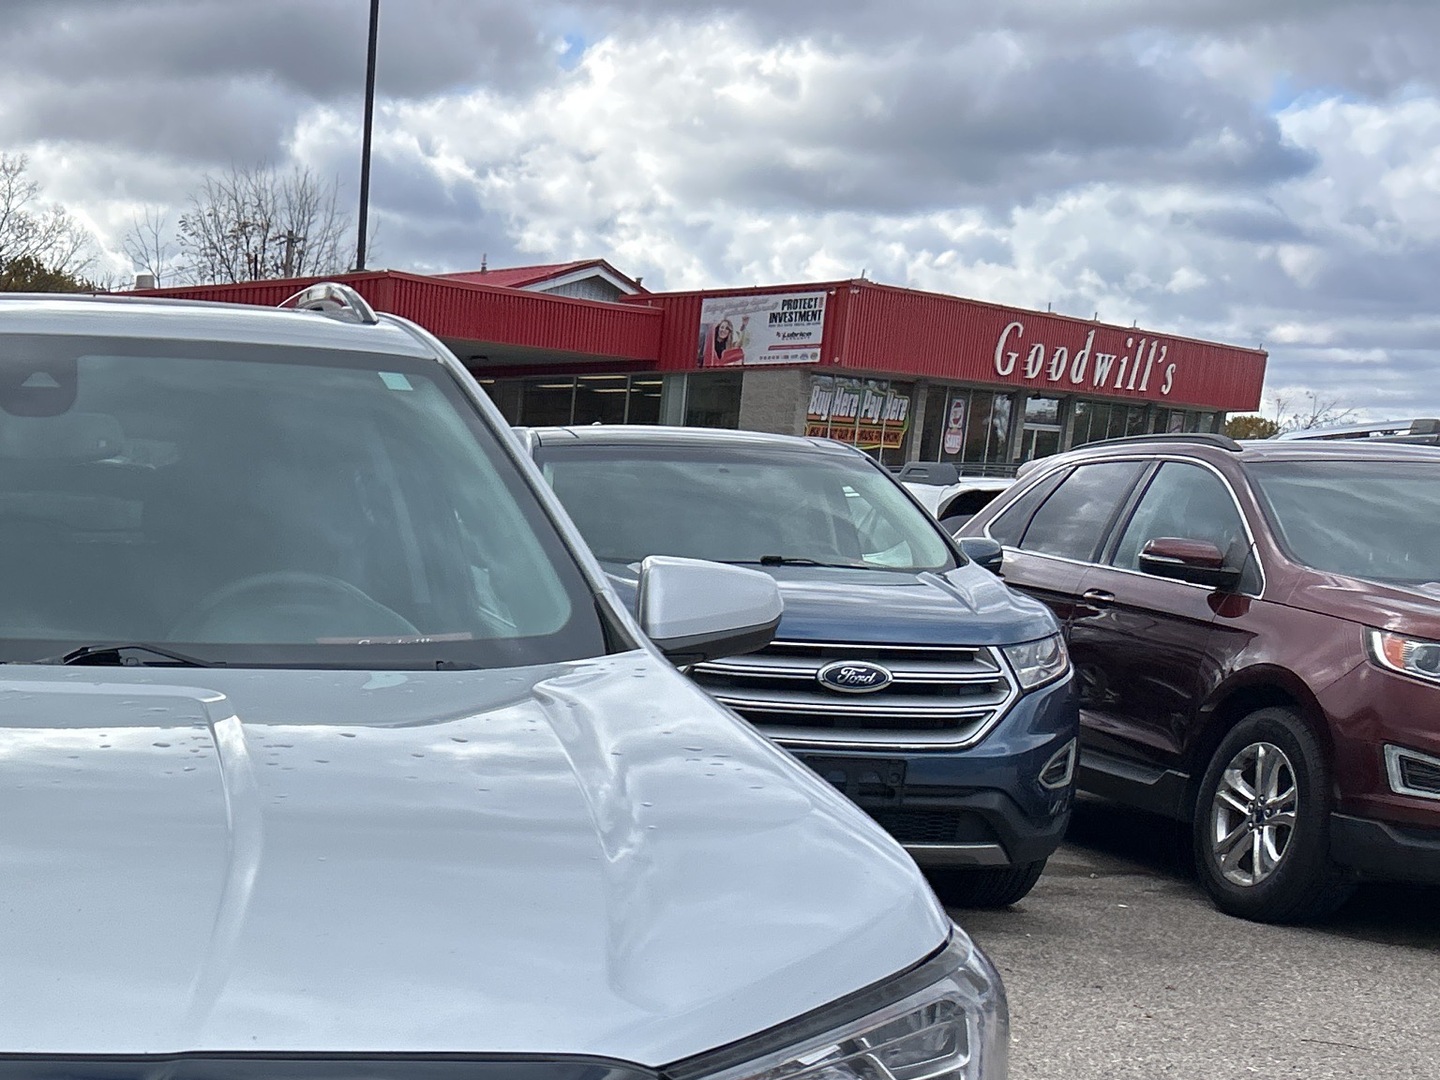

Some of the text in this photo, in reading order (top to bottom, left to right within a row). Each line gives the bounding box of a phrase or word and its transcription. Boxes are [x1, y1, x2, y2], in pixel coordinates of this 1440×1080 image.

[781, 297, 818, 311] PROTECT
[768, 309, 822, 323] INVESTMENT
[994, 321, 1177, 395] Goodwill's
[809, 385, 908, 424] Buy Here Pay Here
[837, 667, 876, 684] Ford
